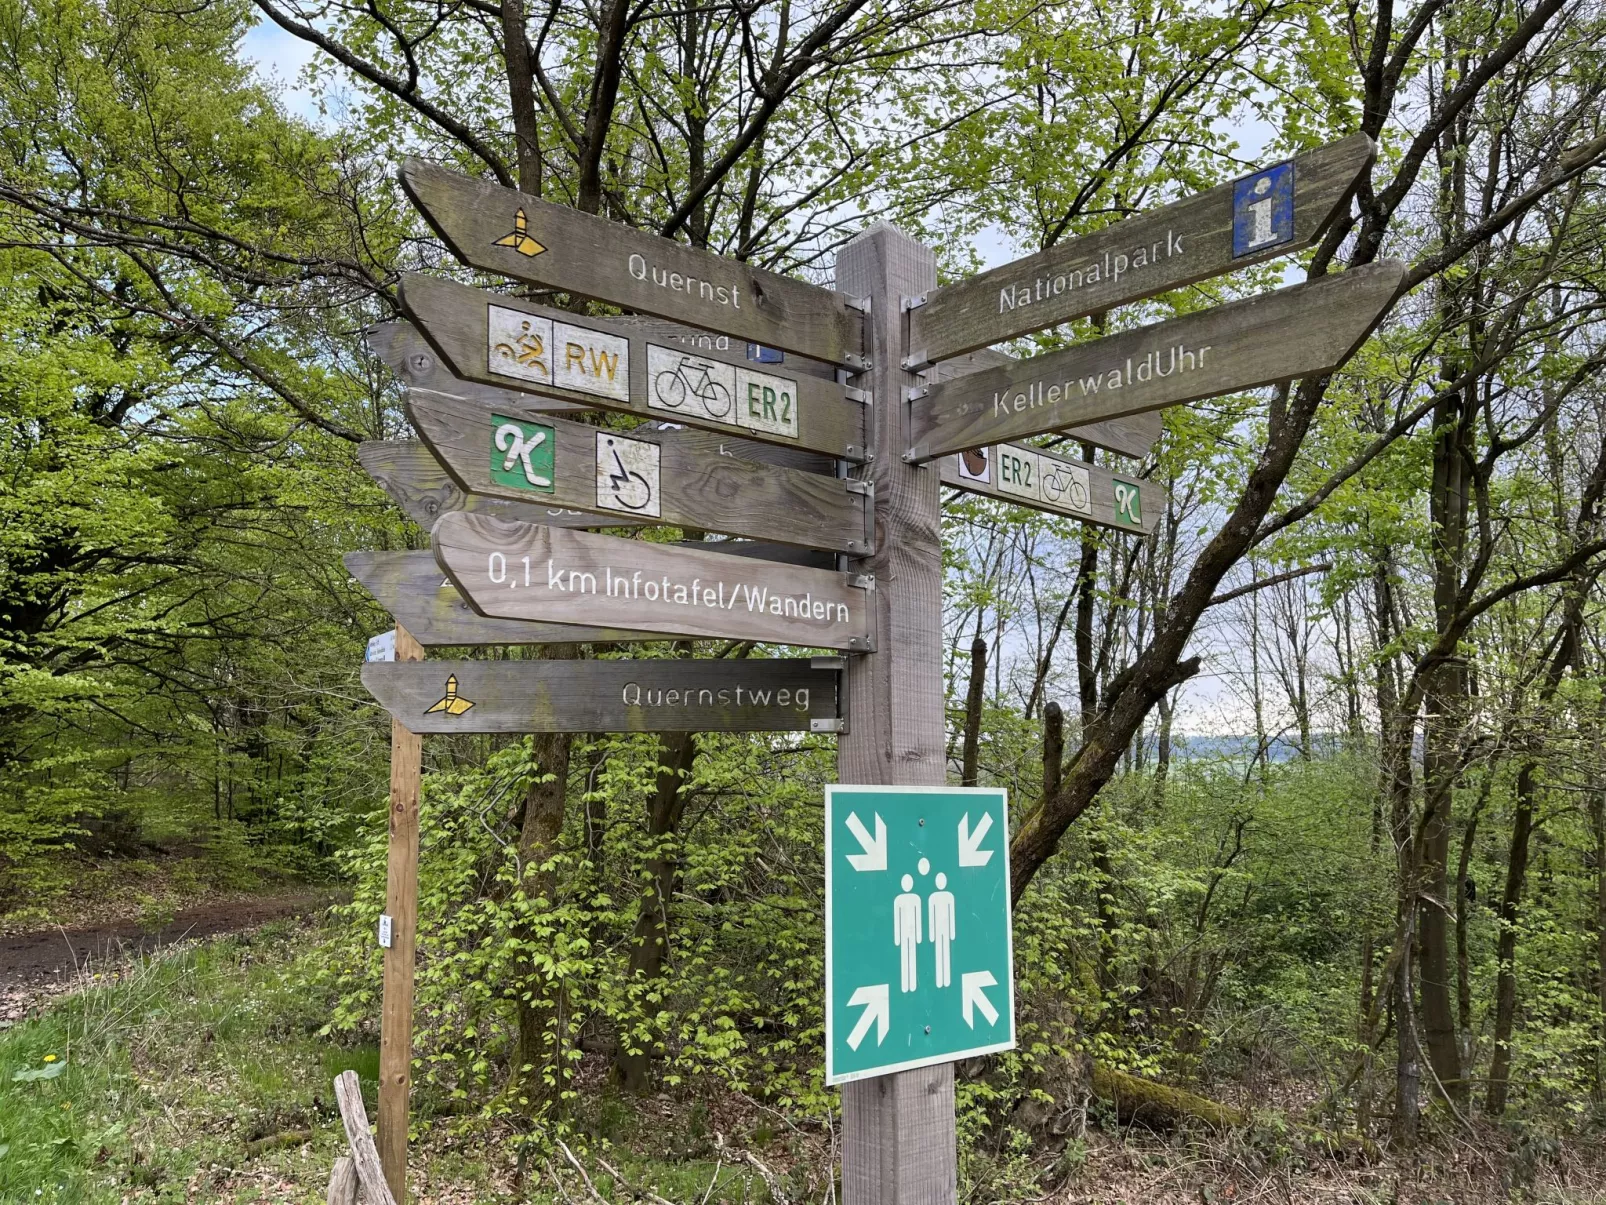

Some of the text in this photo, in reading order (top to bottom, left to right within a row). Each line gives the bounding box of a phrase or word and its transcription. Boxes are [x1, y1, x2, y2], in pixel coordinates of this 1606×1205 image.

[628, 253, 741, 309] Quernst
[999, 230, 1184, 313] Nationalpark
[565, 341, 619, 381] RW
[993, 345, 1212, 419] KellerwaldUhr
[747, 382, 792, 424] ER2
[1001, 453, 1032, 488] ER2
[488, 551, 849, 623] 0,1 km Infotafel/Wandern
[622, 682, 810, 713] Quernstweg
